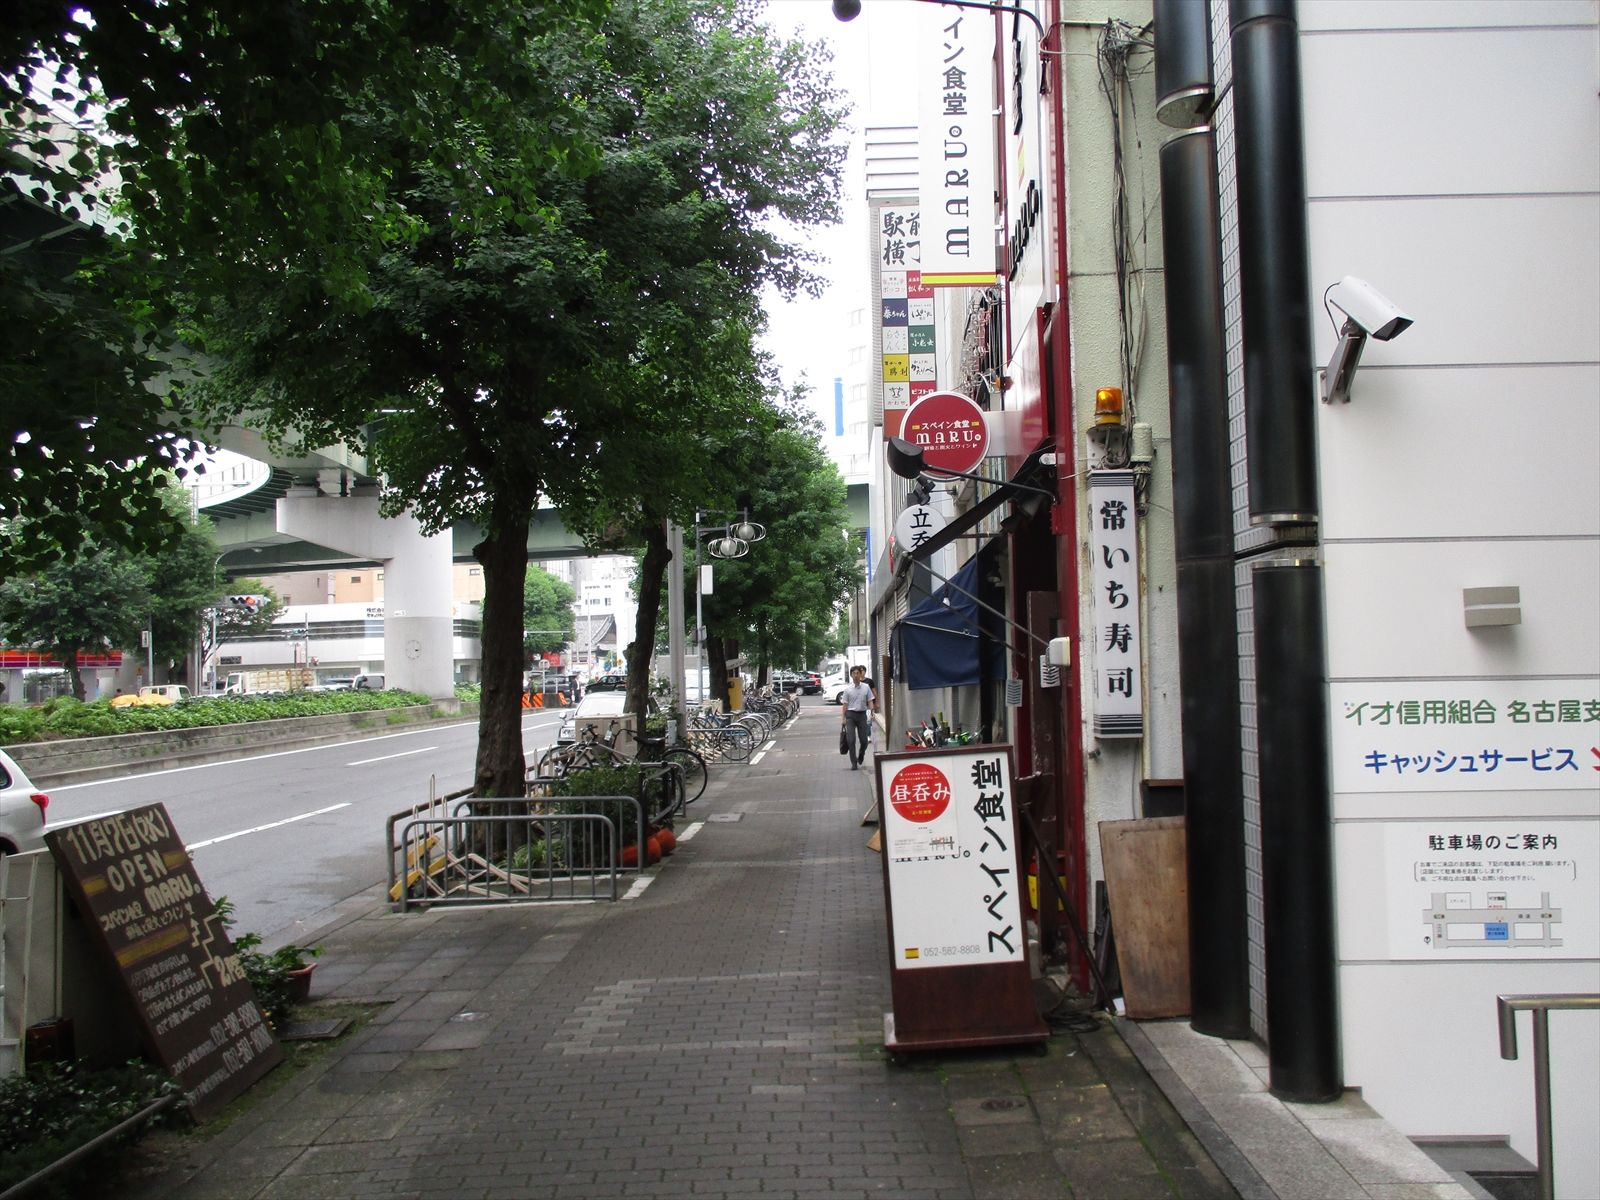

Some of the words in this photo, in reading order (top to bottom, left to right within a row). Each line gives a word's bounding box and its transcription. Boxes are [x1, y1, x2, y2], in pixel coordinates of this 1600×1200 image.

[942, 4, 968, 116] イン食堂
[1100, 500, 1134, 699] 常いち寿司
[1344, 699, 1497, 726] イオ信用組合
[1364, 747, 1579, 774] キャッシュサービス
[891, 782, 951, 805] 昼呑み
[971, 757, 1016, 955] スペイン食堂
[1428, 833, 1558, 851] 駐車場のご案内
[107, 849, 168, 892] OPEN
